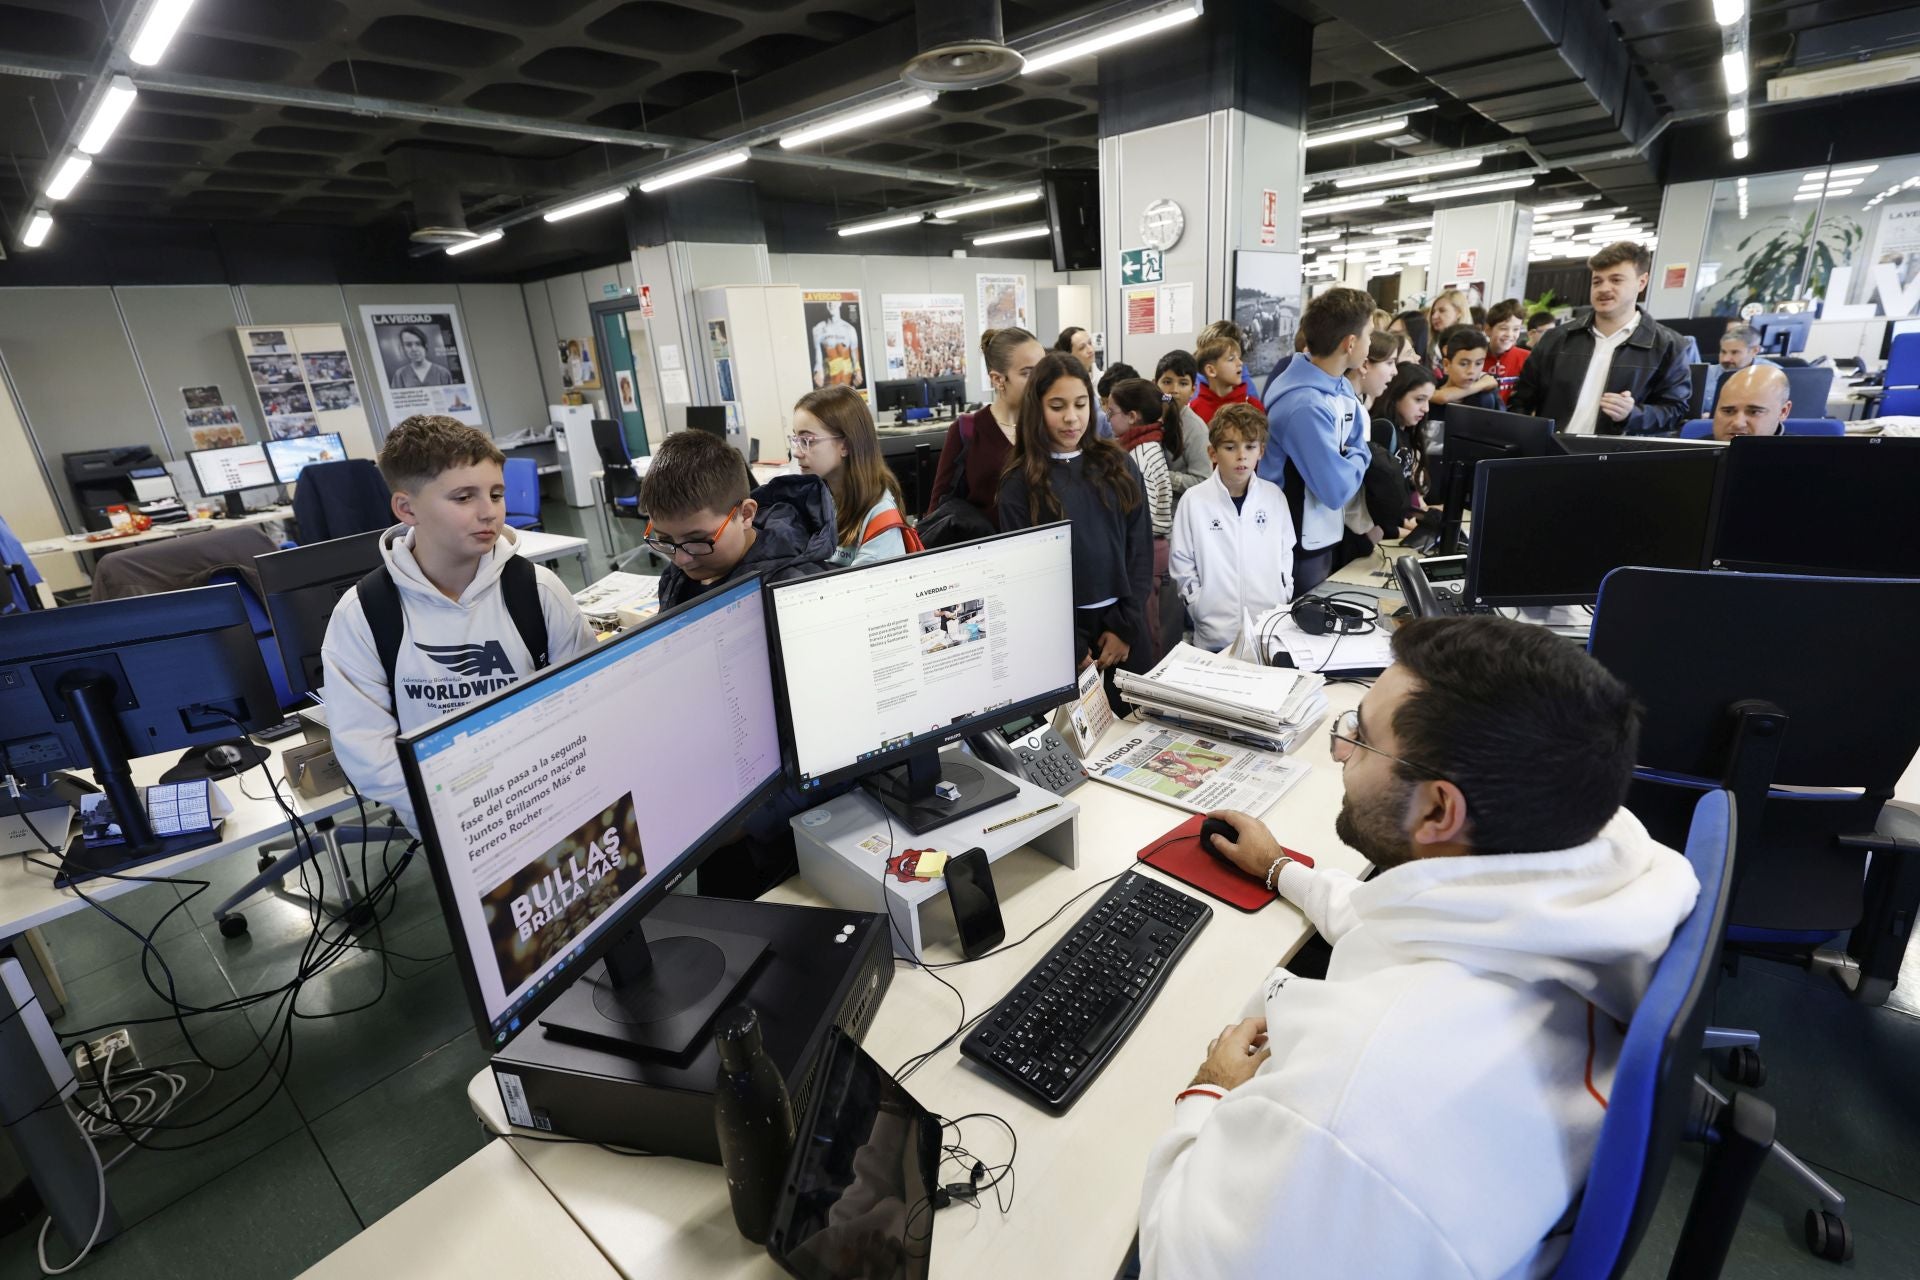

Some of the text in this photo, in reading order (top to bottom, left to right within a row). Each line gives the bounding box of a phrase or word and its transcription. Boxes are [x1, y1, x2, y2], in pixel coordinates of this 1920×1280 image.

[373, 314, 433, 324] LA VERDAD
[915, 590, 924, 598] LA
[924, 585, 948, 596] VERDAD
[472, 784, 505, 808] Bullas
[507, 769, 530, 790] pasa
[539, 758, 549, 768] la
[550, 734, 587, 762] segunda
[1087, 738, 1143, 772] LA VERDAD
[460, 748, 587, 832] fase del concurso nacional
[505, 789, 551, 820] Brillamos
[575, 764, 586, 776] de
[468, 807, 544, 861] Ferrero Rocher
[510, 826, 621, 928] BULLAS
[665, 872, 682, 890] PHILIPS
[518, 882, 585, 943] BRILLA
